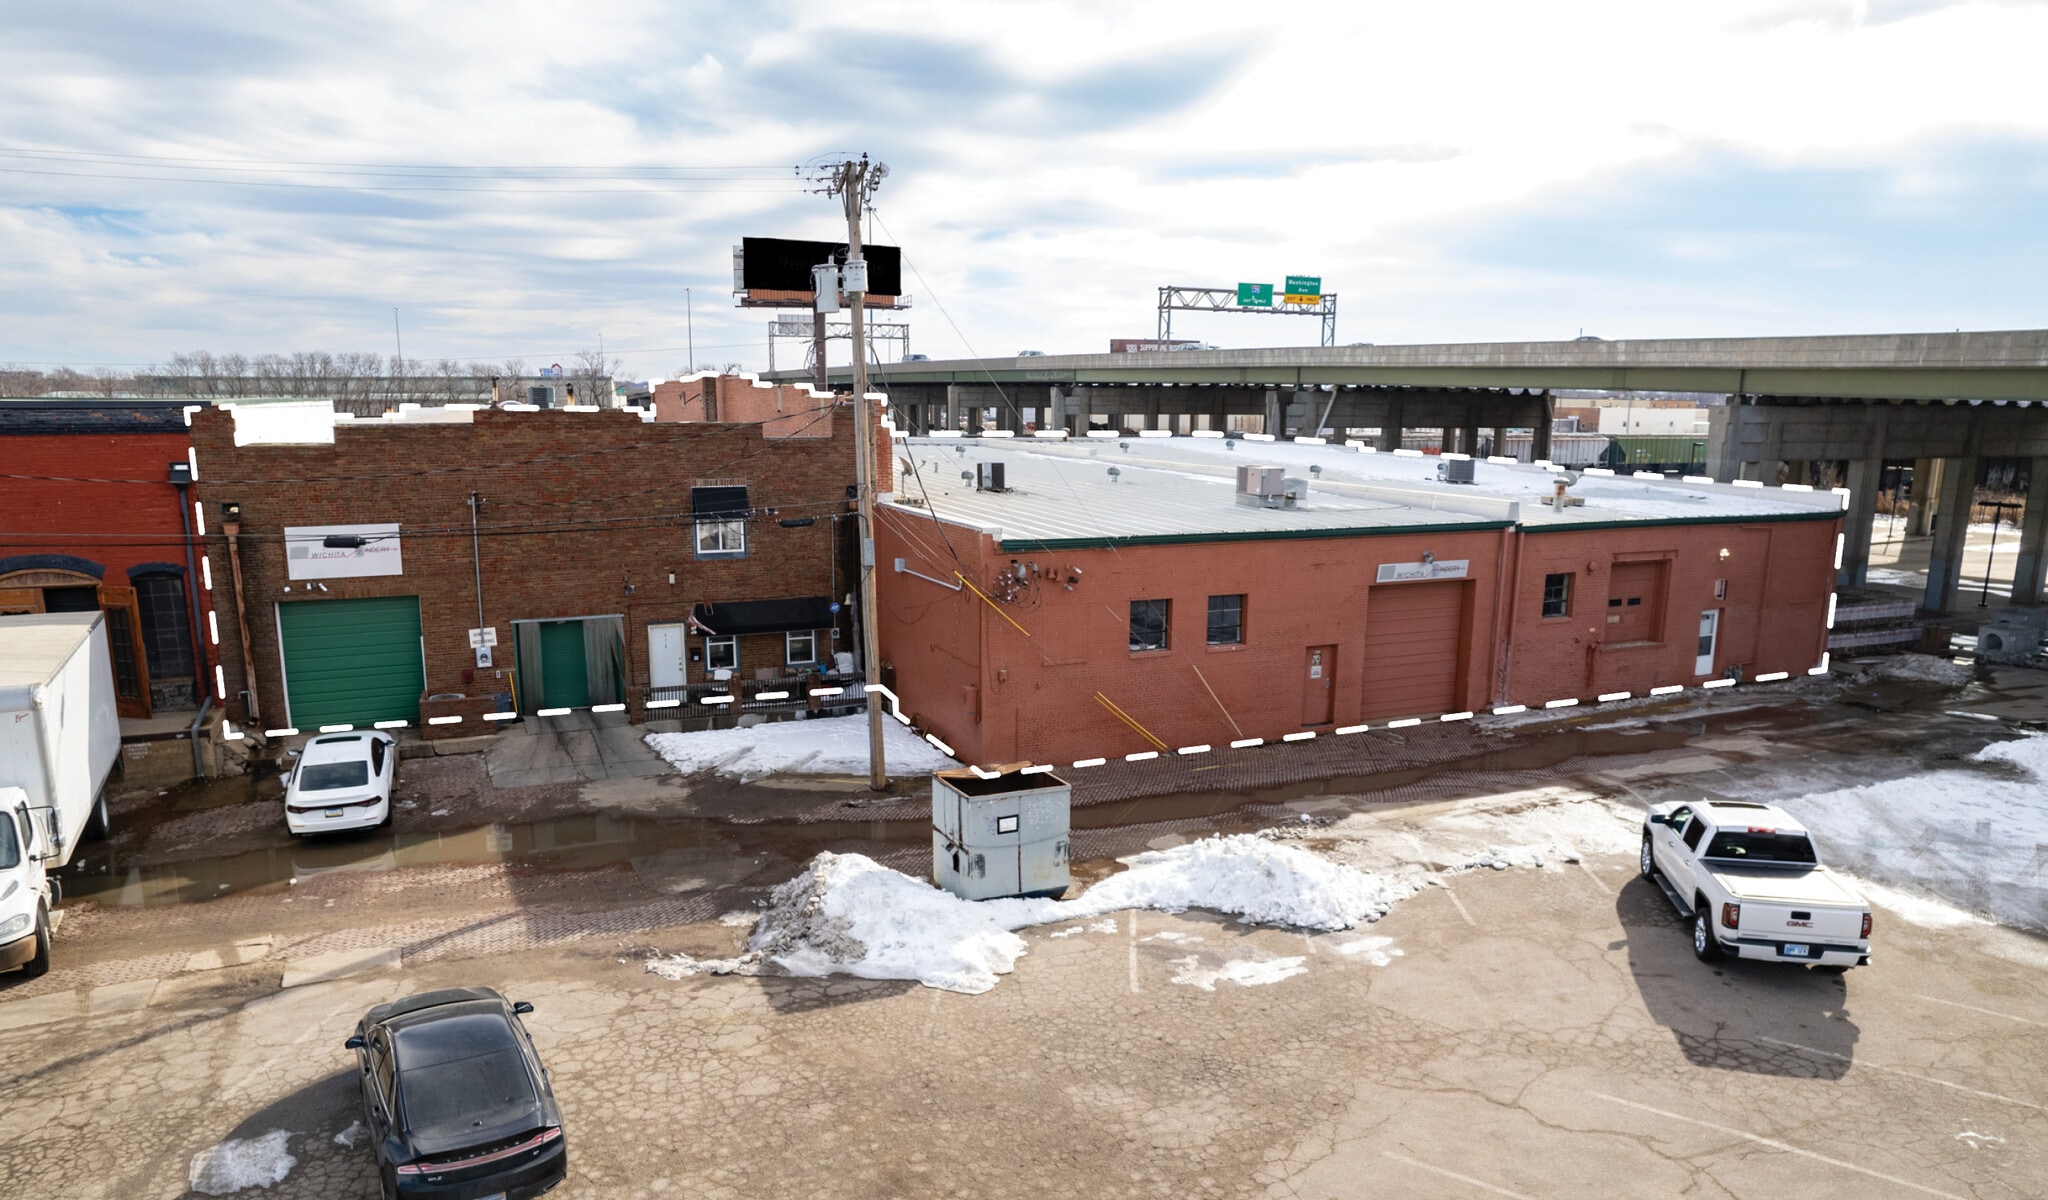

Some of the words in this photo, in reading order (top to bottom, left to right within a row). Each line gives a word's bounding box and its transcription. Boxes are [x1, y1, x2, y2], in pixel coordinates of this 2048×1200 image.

[312, 551, 346, 559] WICHITA
[1397, 570, 1424, 579] WICHITA
[1786, 920, 1814, 929] GMC
